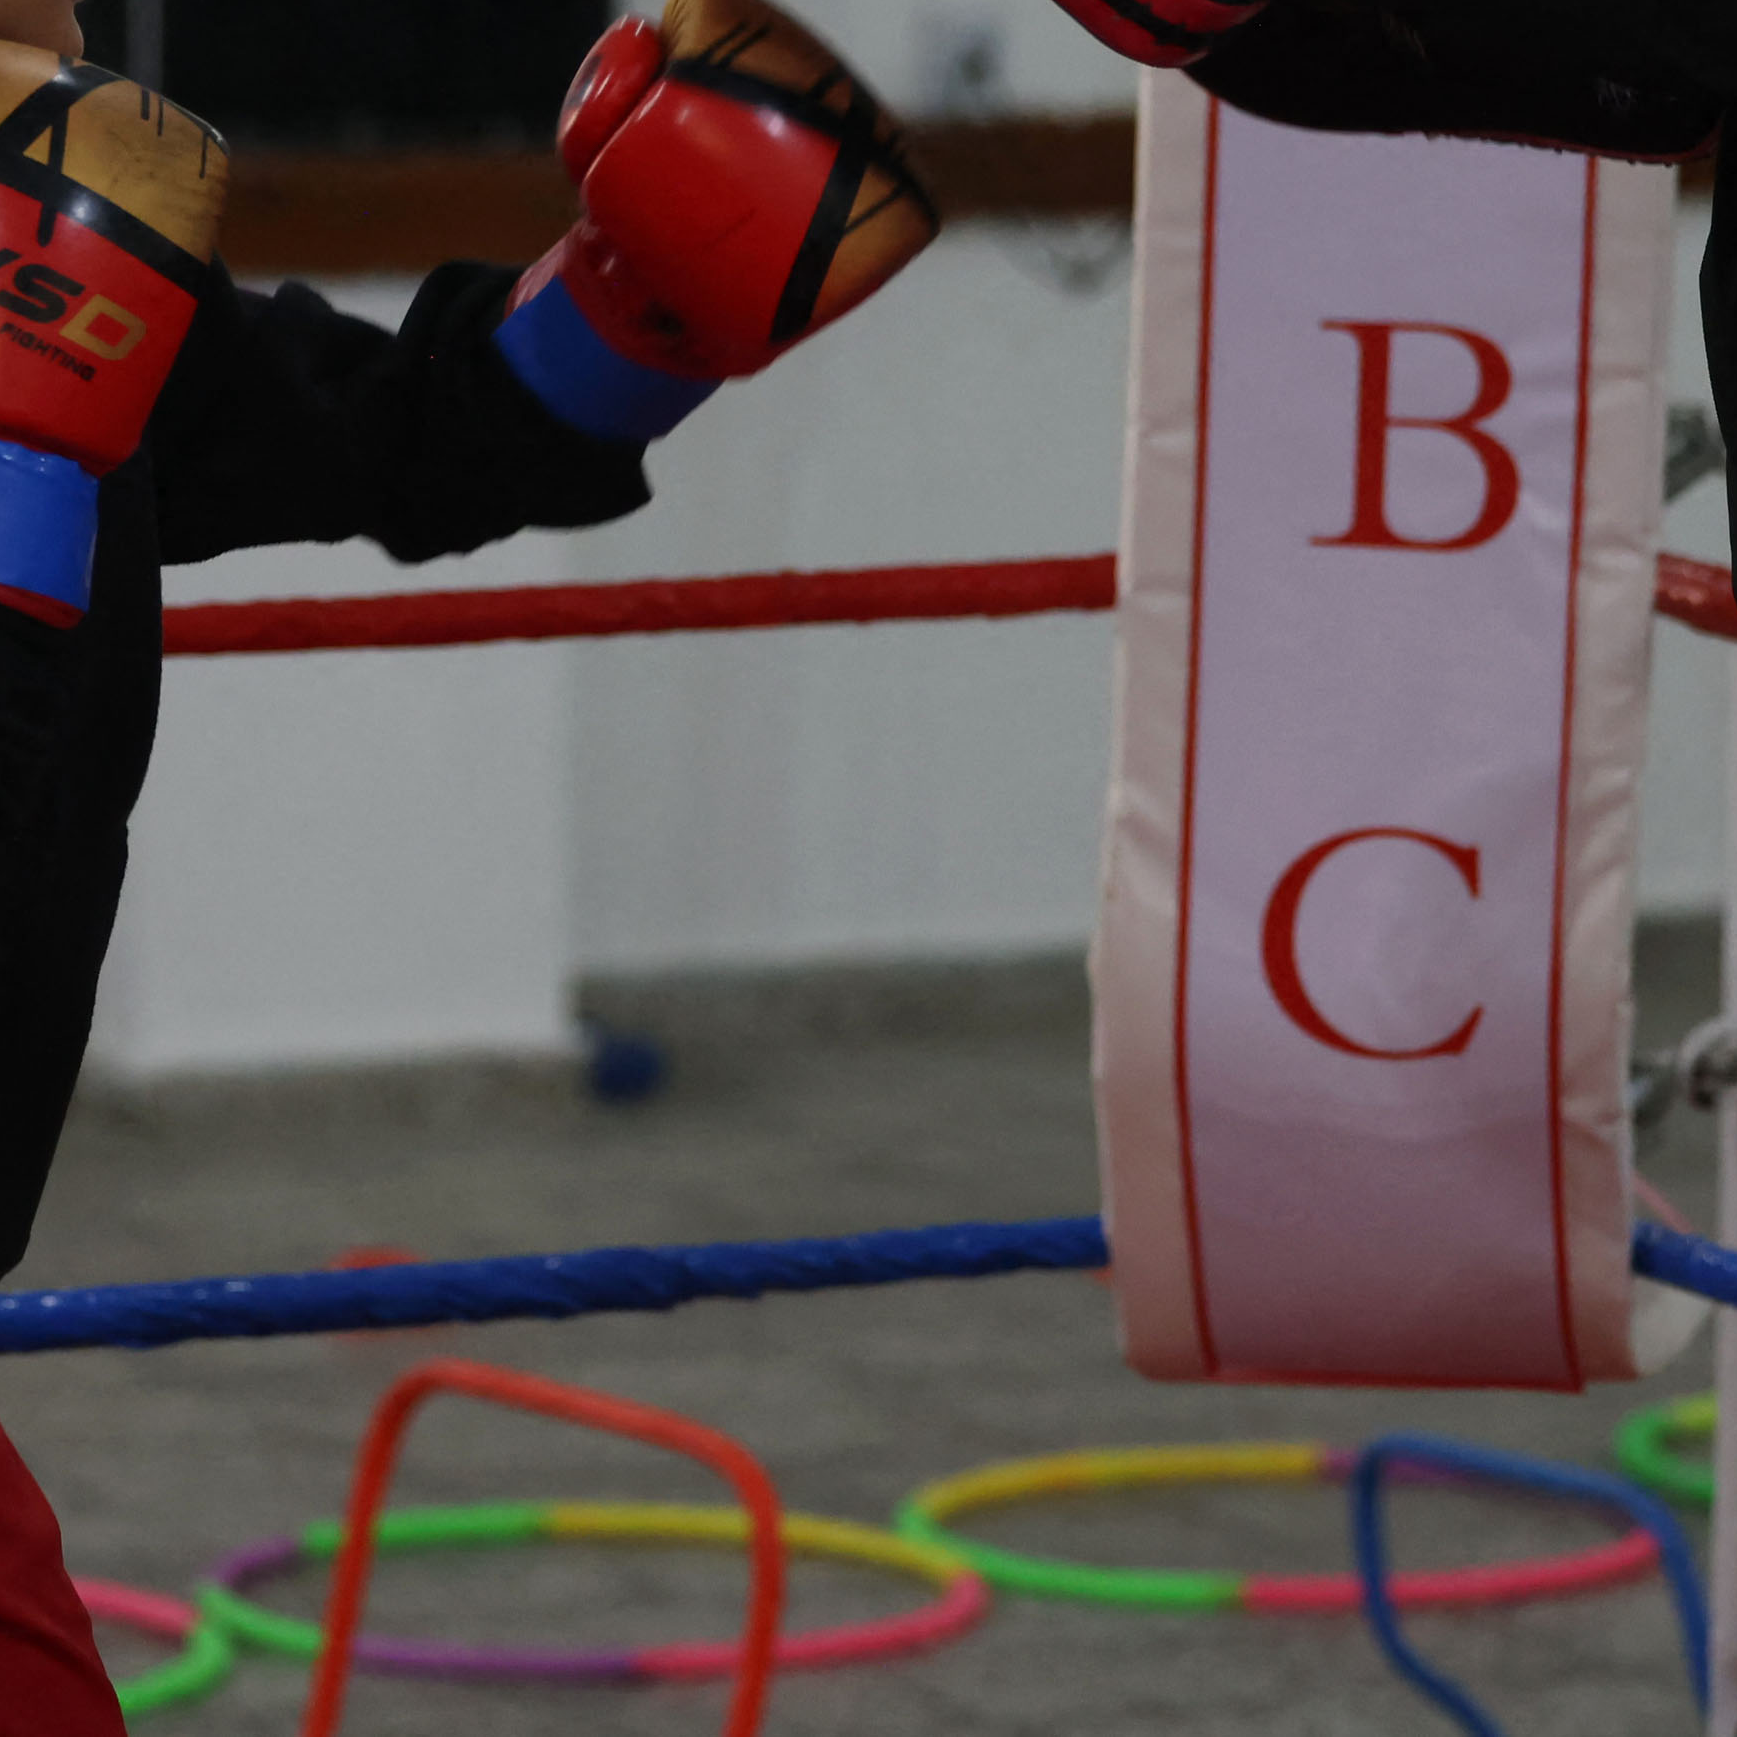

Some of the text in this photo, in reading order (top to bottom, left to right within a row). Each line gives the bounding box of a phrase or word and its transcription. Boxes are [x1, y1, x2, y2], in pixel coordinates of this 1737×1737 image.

[0, 322, 96, 381] FIGHTING
[1312, 320, 1524, 554] B
[1262, 827, 1484, 1061] C
